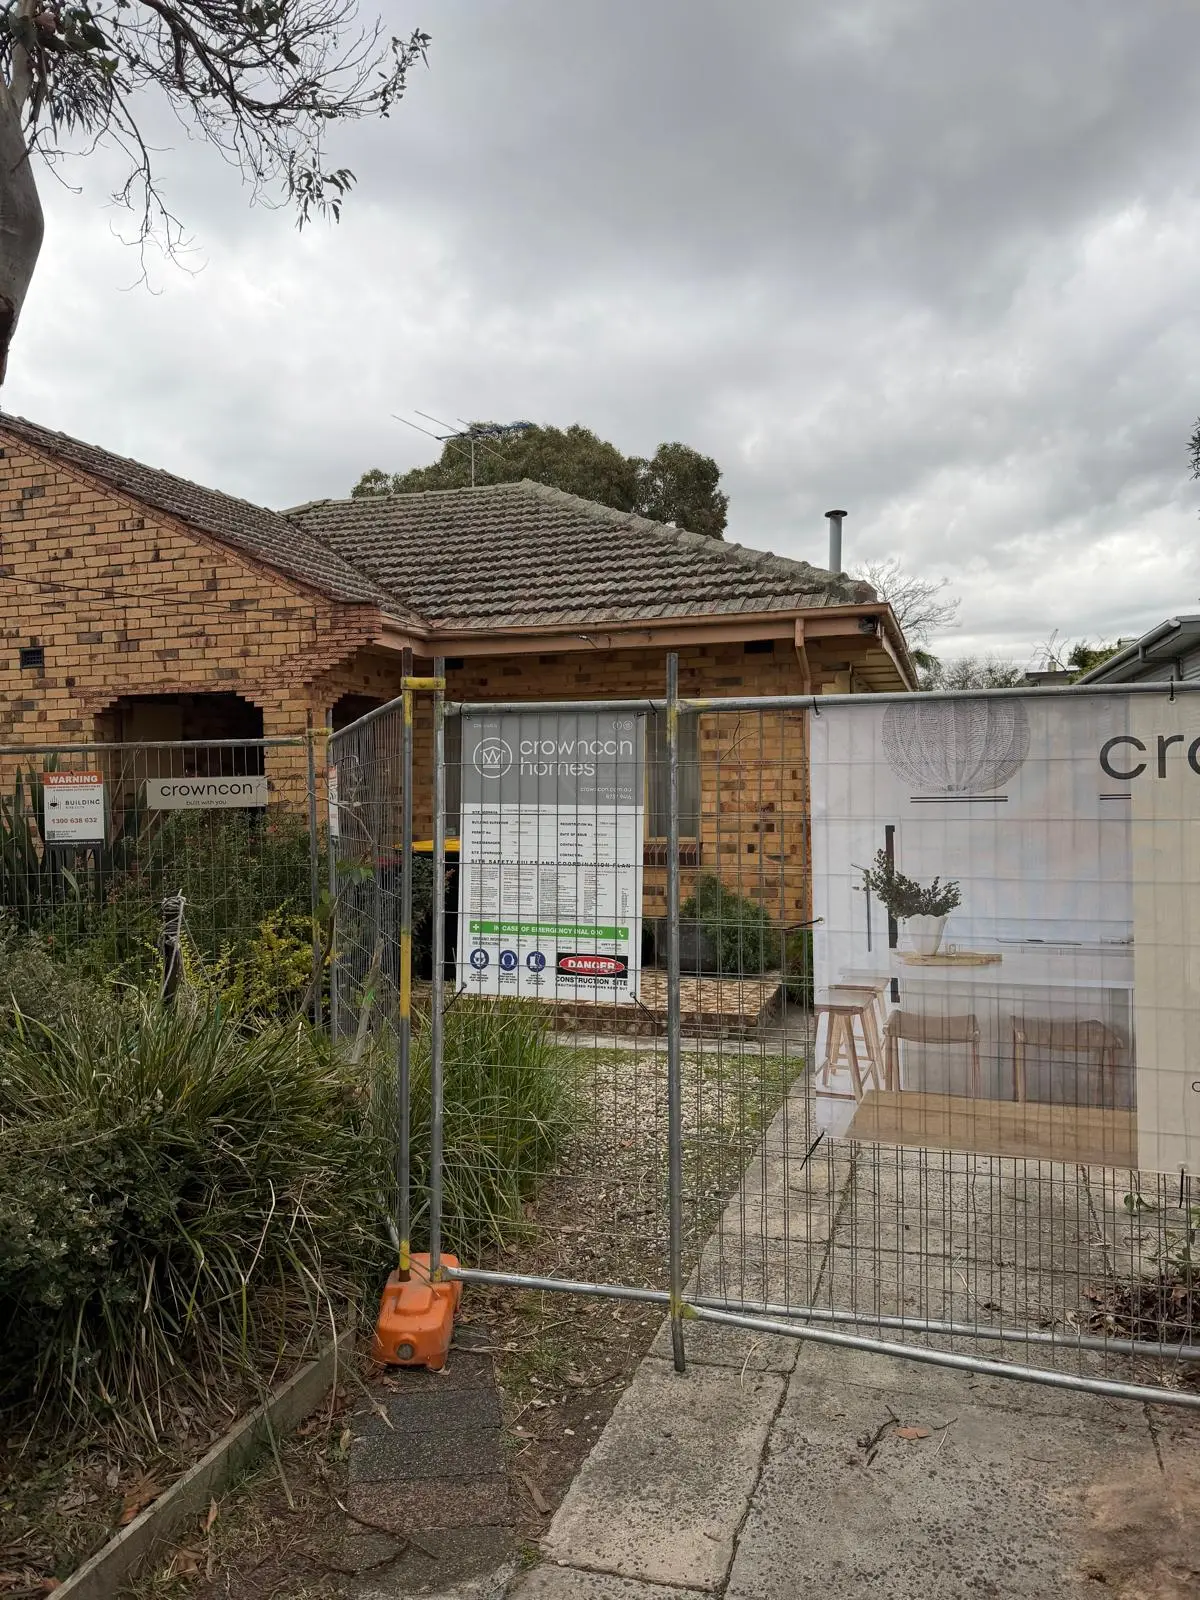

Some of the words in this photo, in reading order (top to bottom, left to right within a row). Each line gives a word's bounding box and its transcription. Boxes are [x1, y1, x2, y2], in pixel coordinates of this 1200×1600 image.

[520, 740, 633, 755] crowncon
[1100, 734, 1200, 780] cr
[520, 757, 595, 776] homes
[49, 775, 98, 784] WARNING
[160, 783, 253, 797] crowncon
[531, 926, 573, 935] EMERGENCY
[568, 959, 616, 970] DANGER
[555, 975, 610, 985] CONSTRUCTION
[612, 979, 628, 987] SITE
